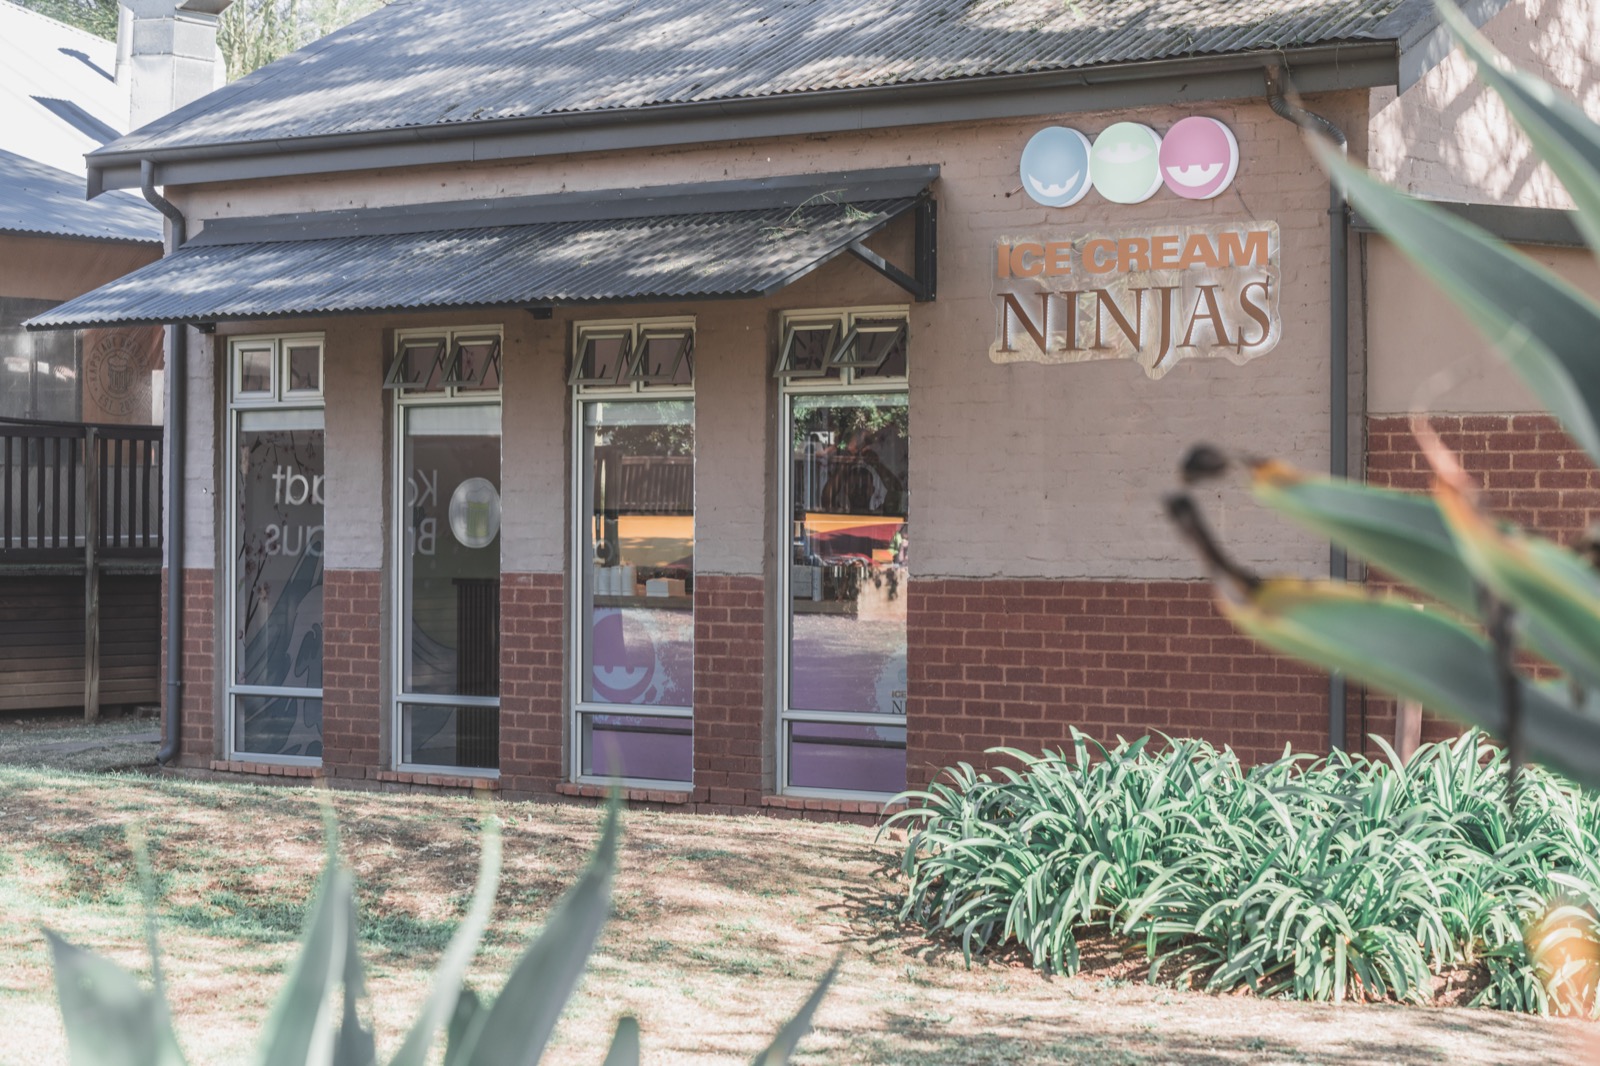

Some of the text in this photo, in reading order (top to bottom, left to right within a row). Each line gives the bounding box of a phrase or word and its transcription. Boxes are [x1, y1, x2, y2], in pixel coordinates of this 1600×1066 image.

[997, 230, 1269, 279] ICE CREAM
[996, 275, 1271, 369] NINJAS
